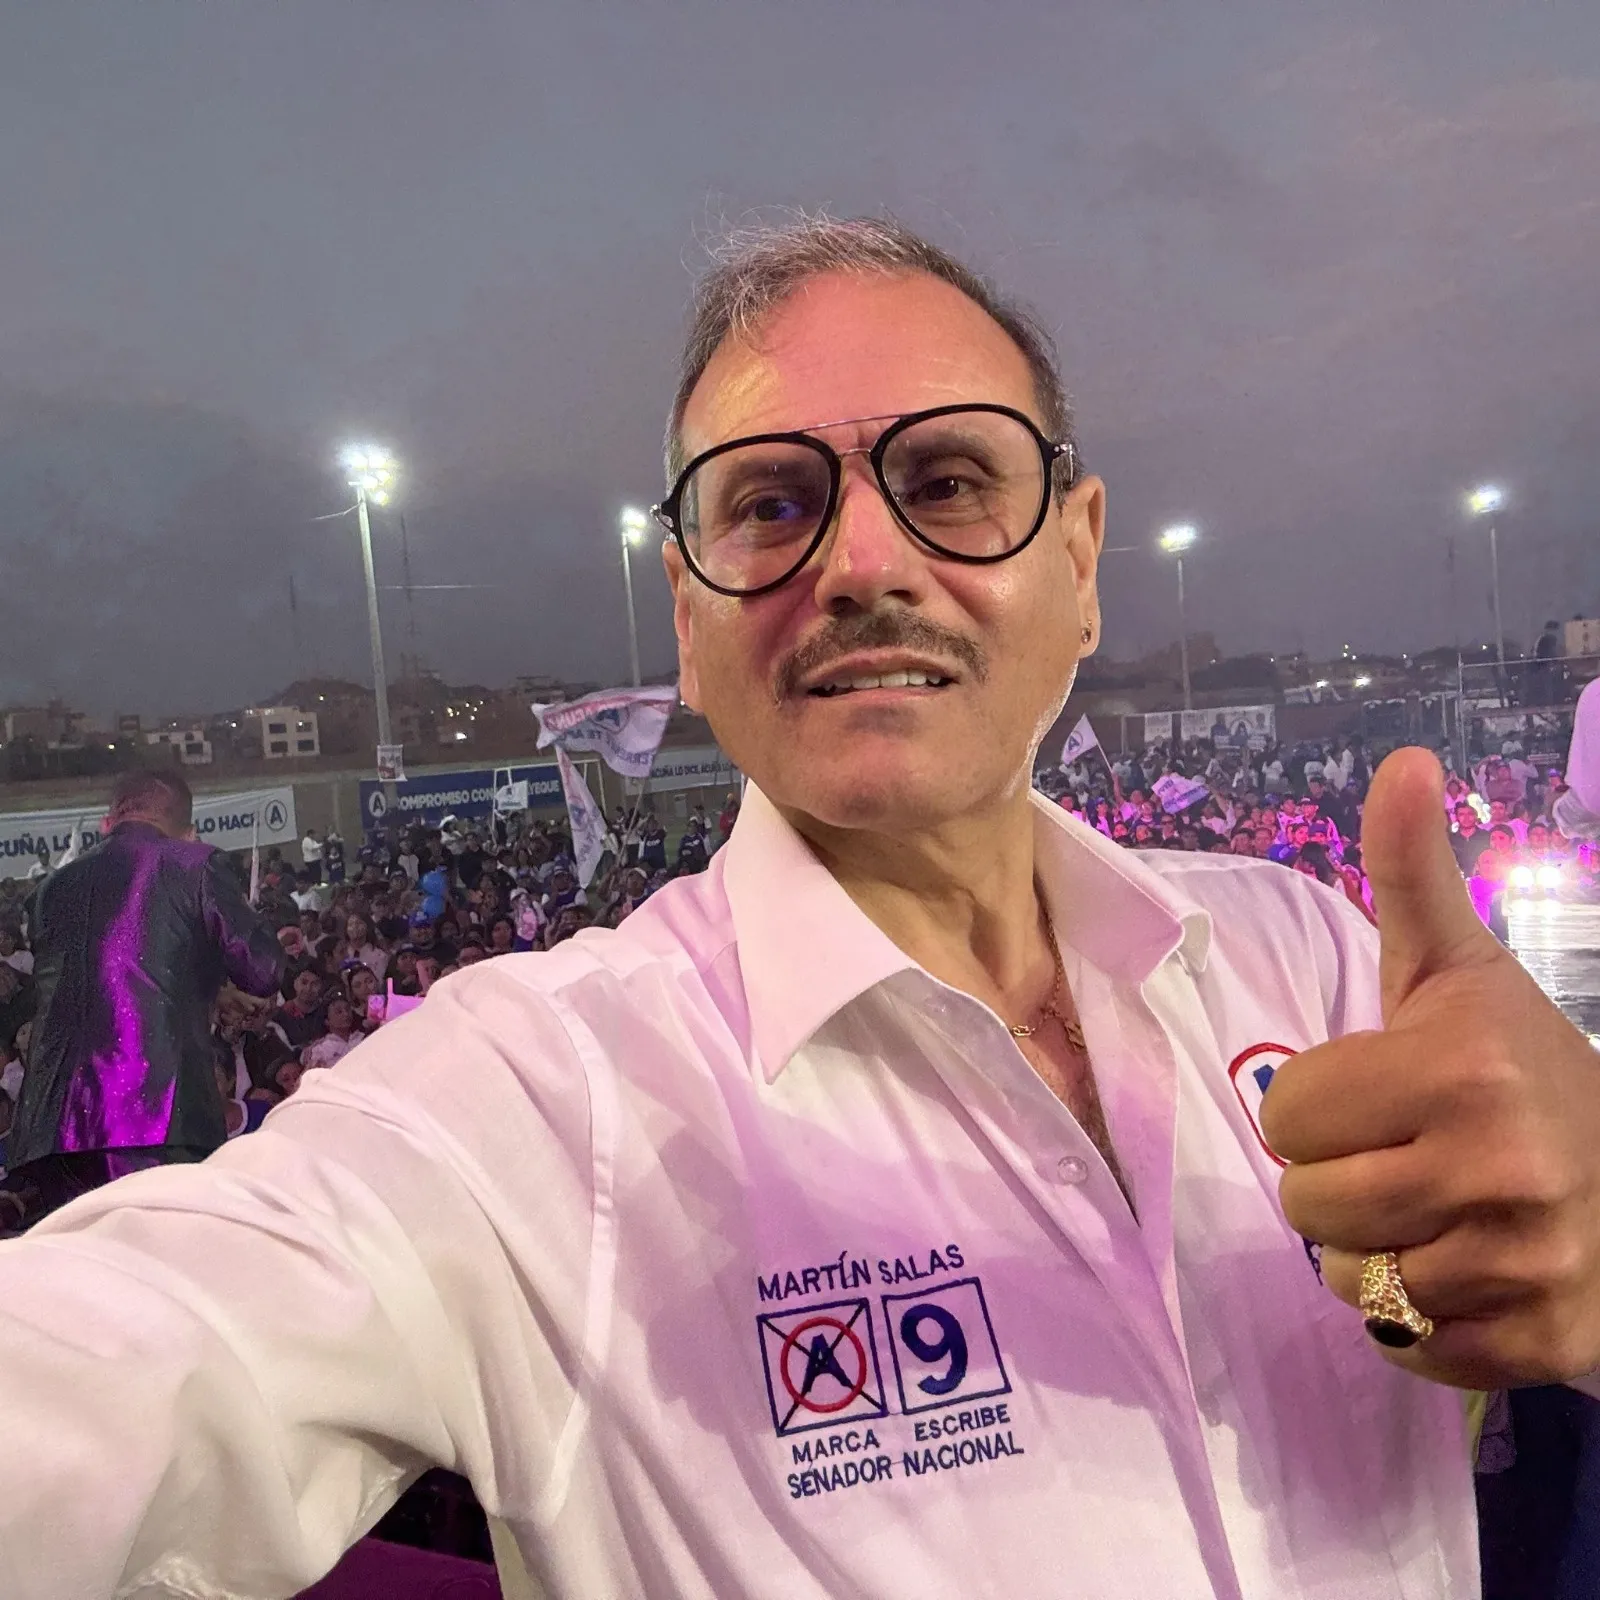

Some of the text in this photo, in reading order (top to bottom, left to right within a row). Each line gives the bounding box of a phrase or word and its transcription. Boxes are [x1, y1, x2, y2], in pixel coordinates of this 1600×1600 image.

[195, 817, 216, 834] LO
[757, 1244, 965, 1302] MARTÍN SALAS
[802, 1303, 969, 1396] A 9
[787, 1430, 1025, 1500] SENADOR NACIONAL
[791, 1403, 1011, 1465] MARCA ESCRIBE
